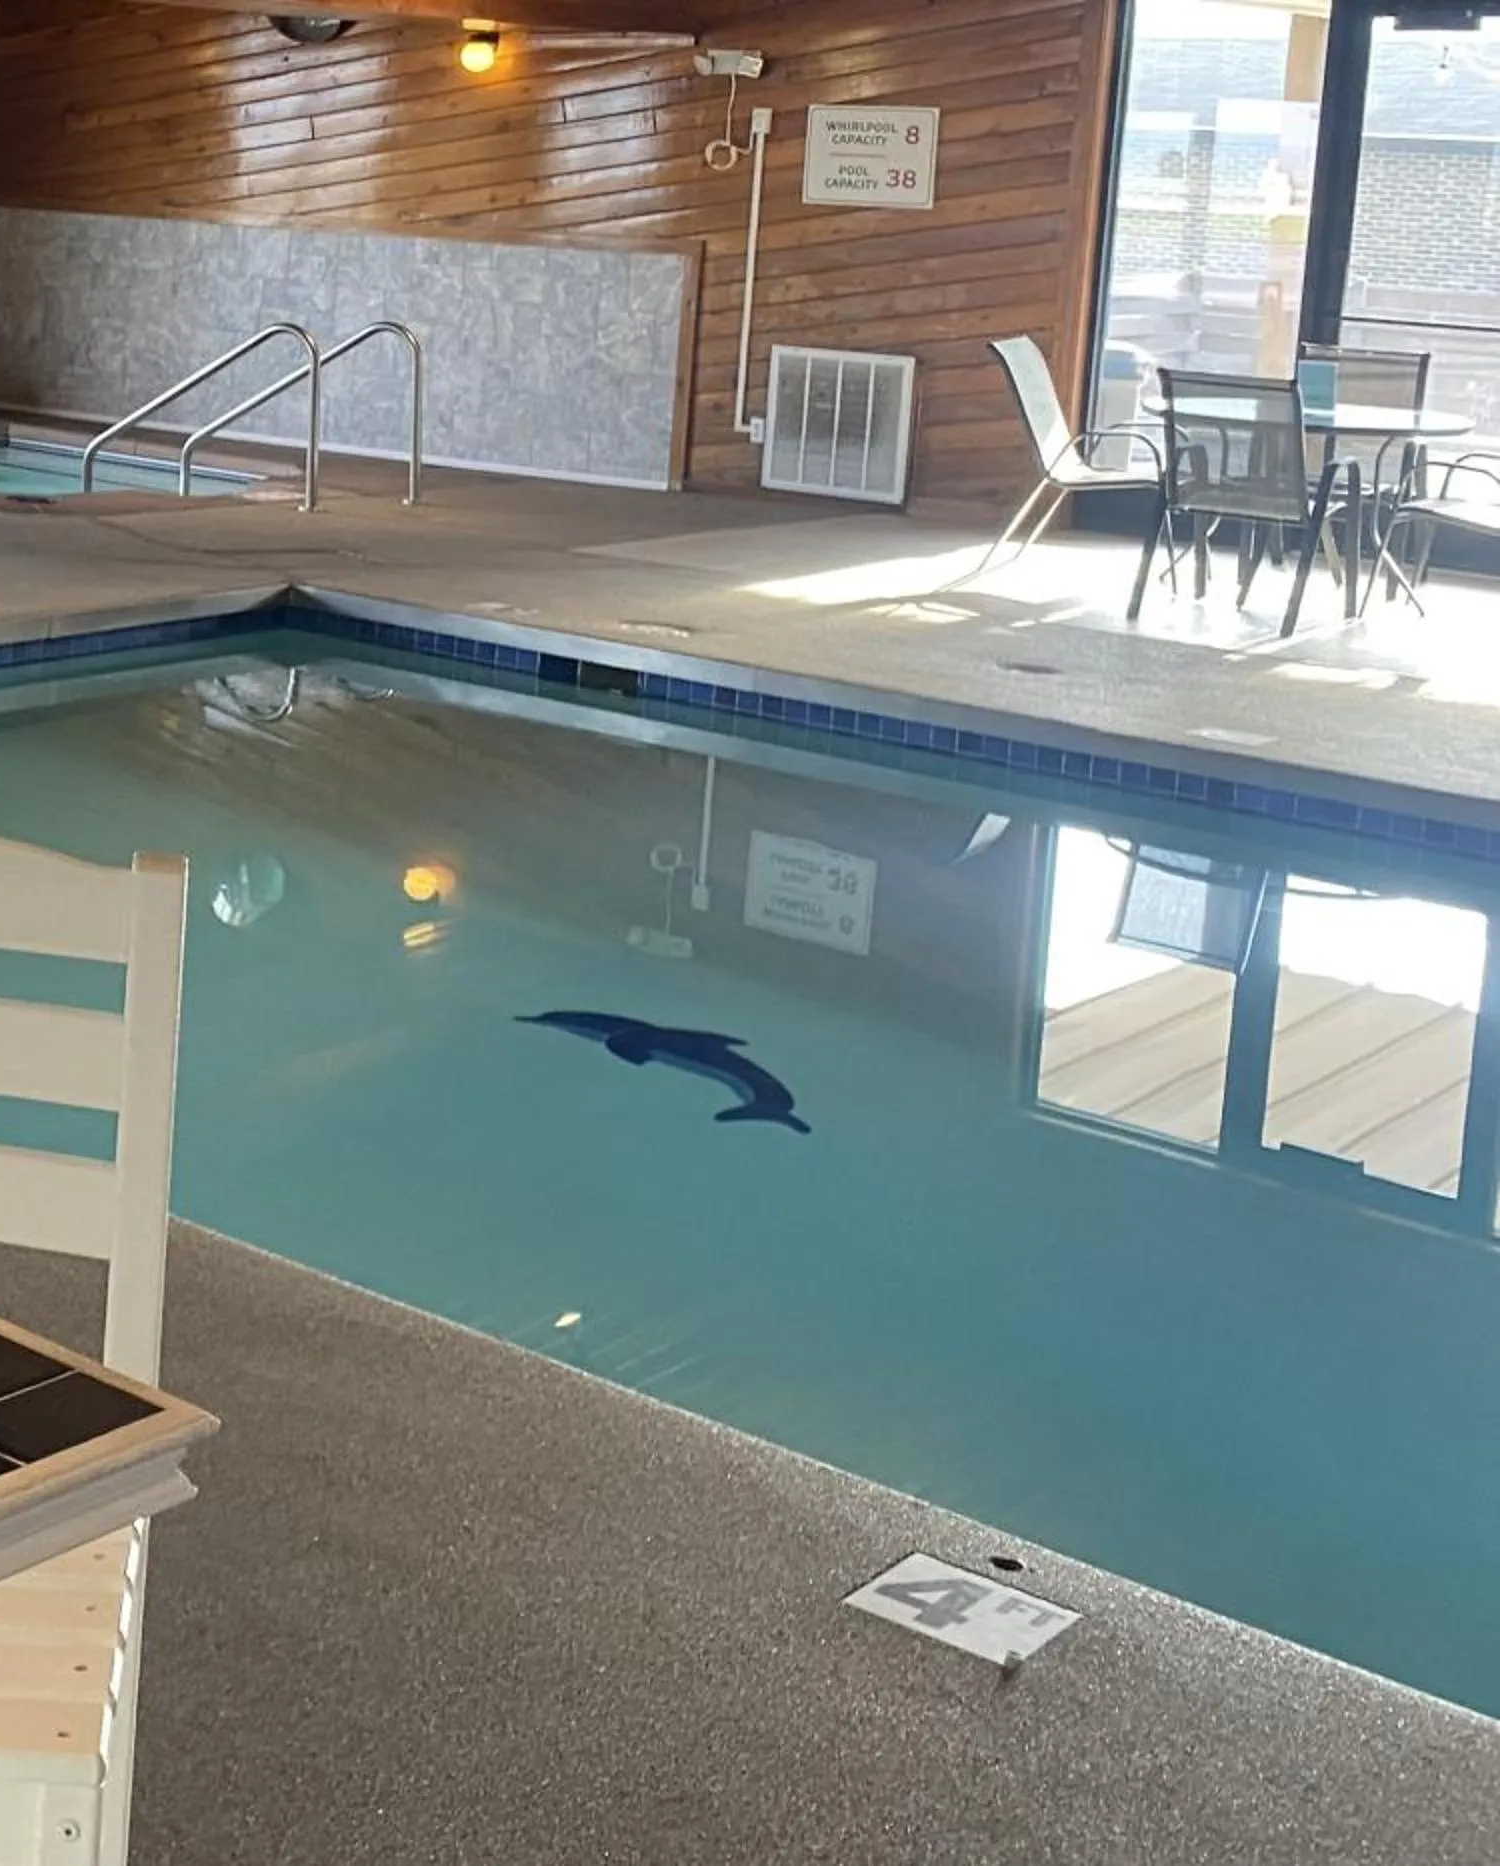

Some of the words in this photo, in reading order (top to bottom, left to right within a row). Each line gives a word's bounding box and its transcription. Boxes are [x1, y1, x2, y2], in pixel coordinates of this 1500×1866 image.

[825, 121, 898, 134] WHIRLPOOL
[831, 134, 888, 145] CAPACITY
[905, 125, 920, 145] 8
[838, 165, 869, 176] POOL
[824, 178, 879, 190] CAPACITY
[885, 168, 917, 189] 38
[874, 1578, 994, 1630] 4
